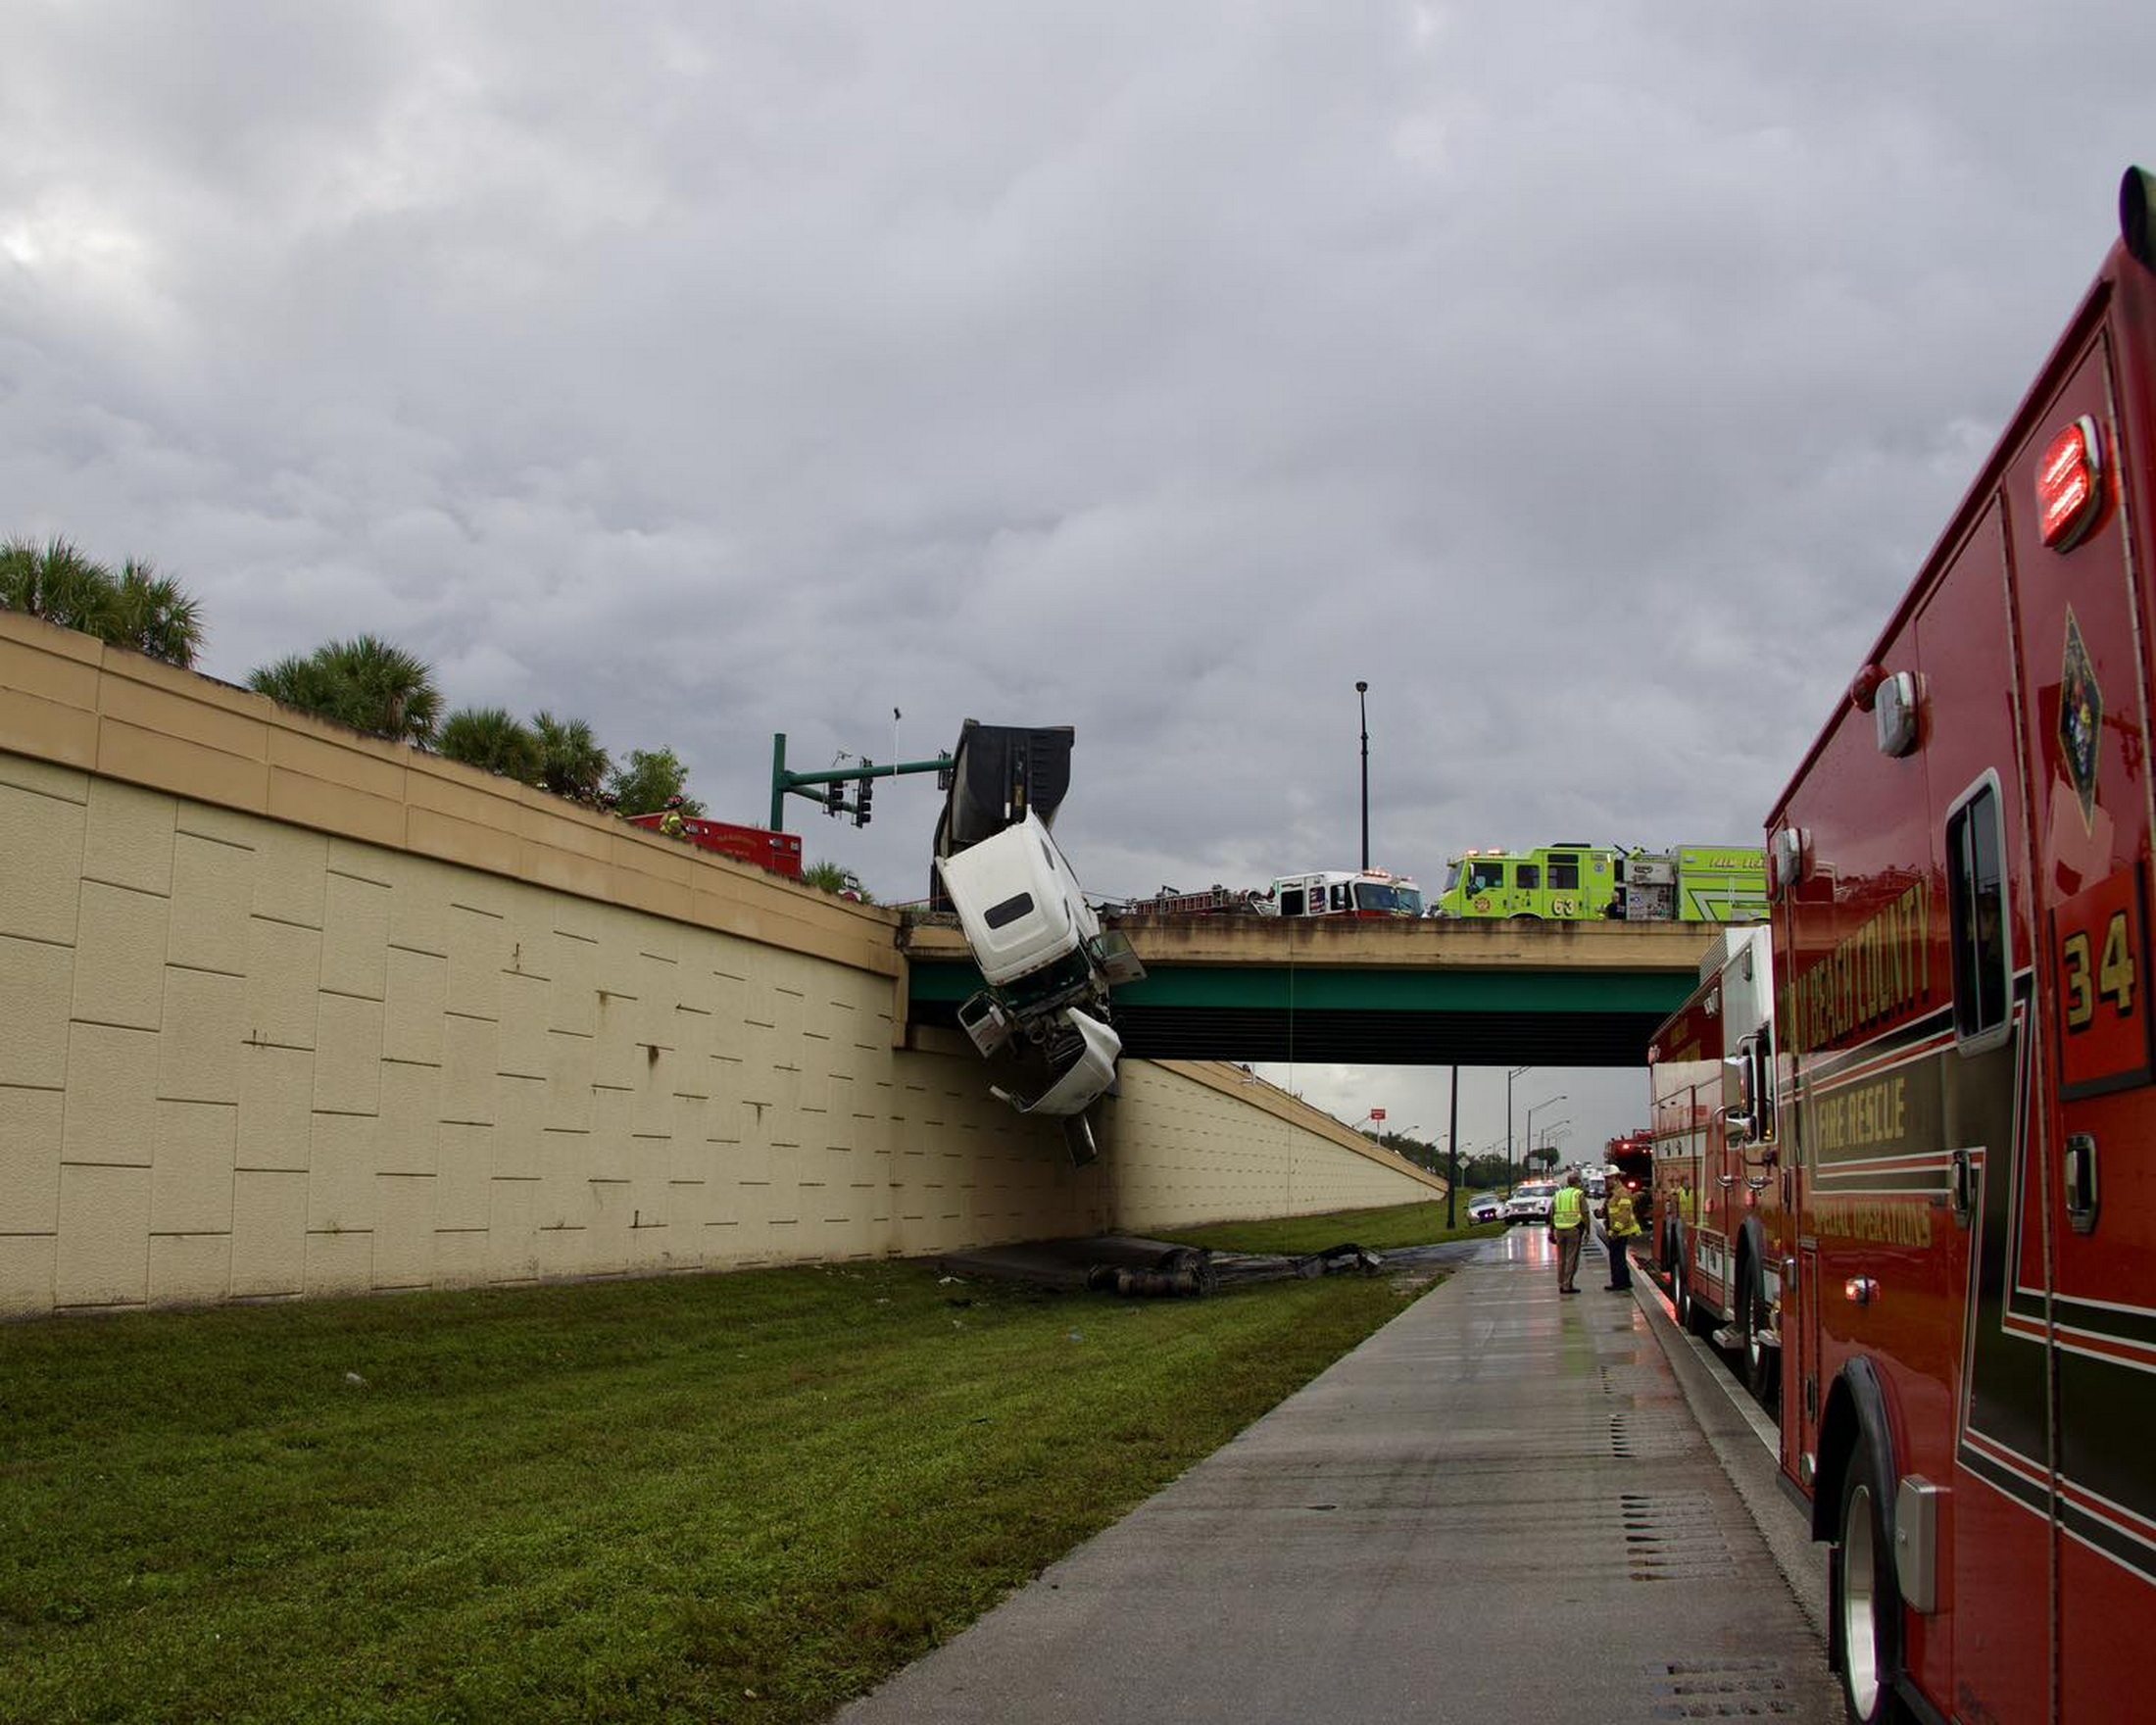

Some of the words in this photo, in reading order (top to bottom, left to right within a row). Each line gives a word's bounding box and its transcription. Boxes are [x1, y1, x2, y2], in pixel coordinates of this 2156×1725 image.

[1552, 897, 1574, 916] 63
[1810, 937, 1853, 1047] BEACH
[1856, 875, 1930, 1025] COUNTY
[2063, 913, 2135, 1027] 34
[1818, 1096, 1844, 1151] FIRE
[1847, 1077, 1906, 1145] RESCUE
[1854, 1200, 1932, 1248] OPERATIONS
